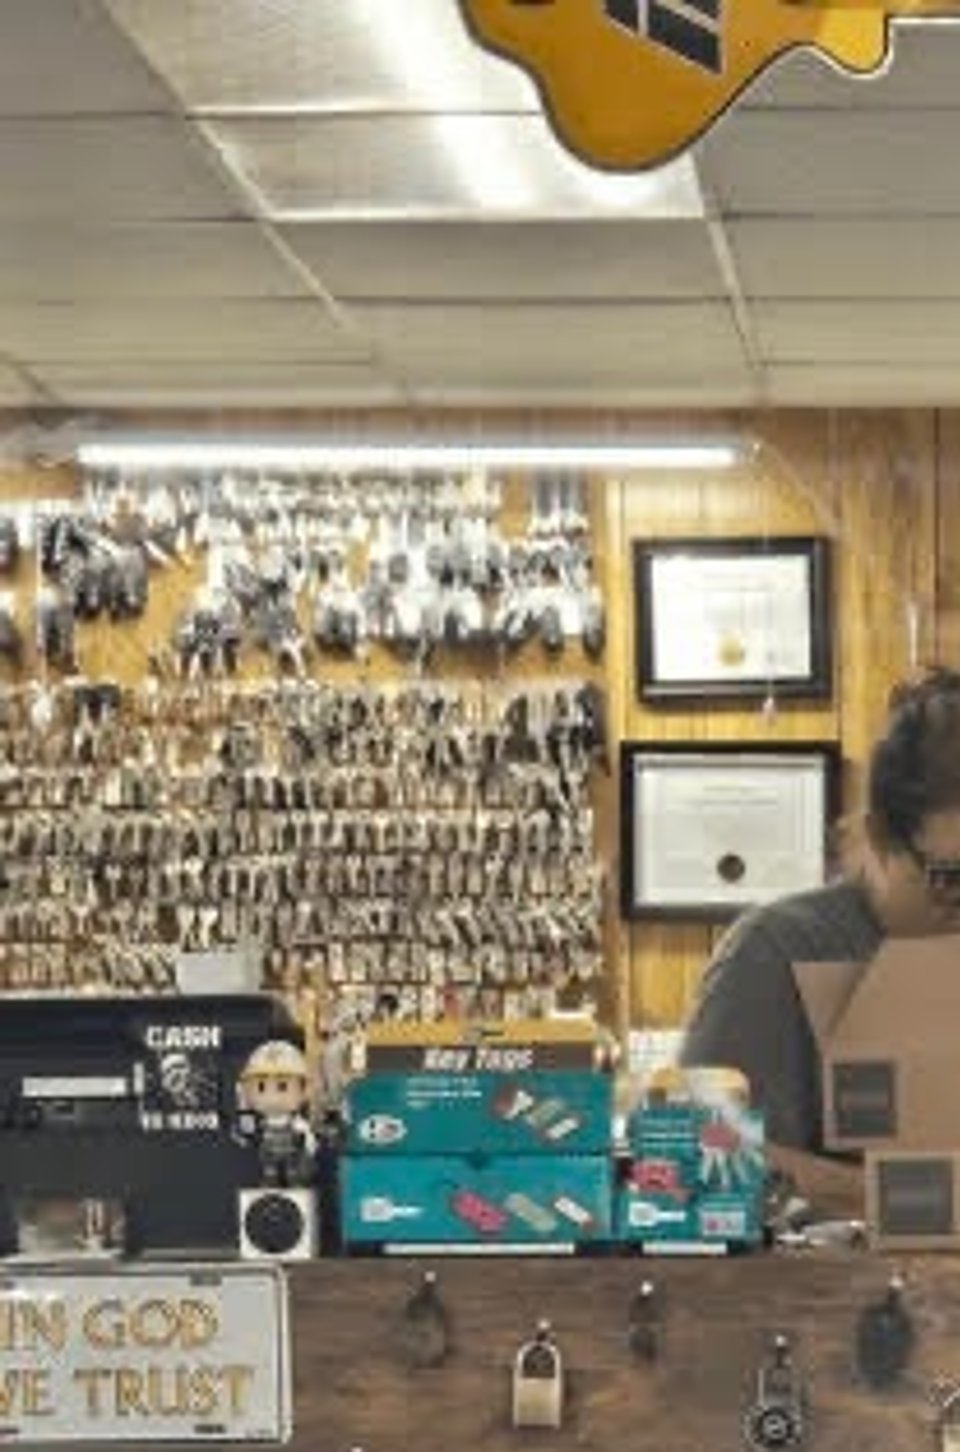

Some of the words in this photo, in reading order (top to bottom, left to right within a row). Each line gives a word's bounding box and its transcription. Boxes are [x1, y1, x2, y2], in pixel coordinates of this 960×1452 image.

[146, 1025, 222, 1047] CASH
[82, 1300, 219, 1351] GOD
[73, 1366, 255, 1417] TRUST
